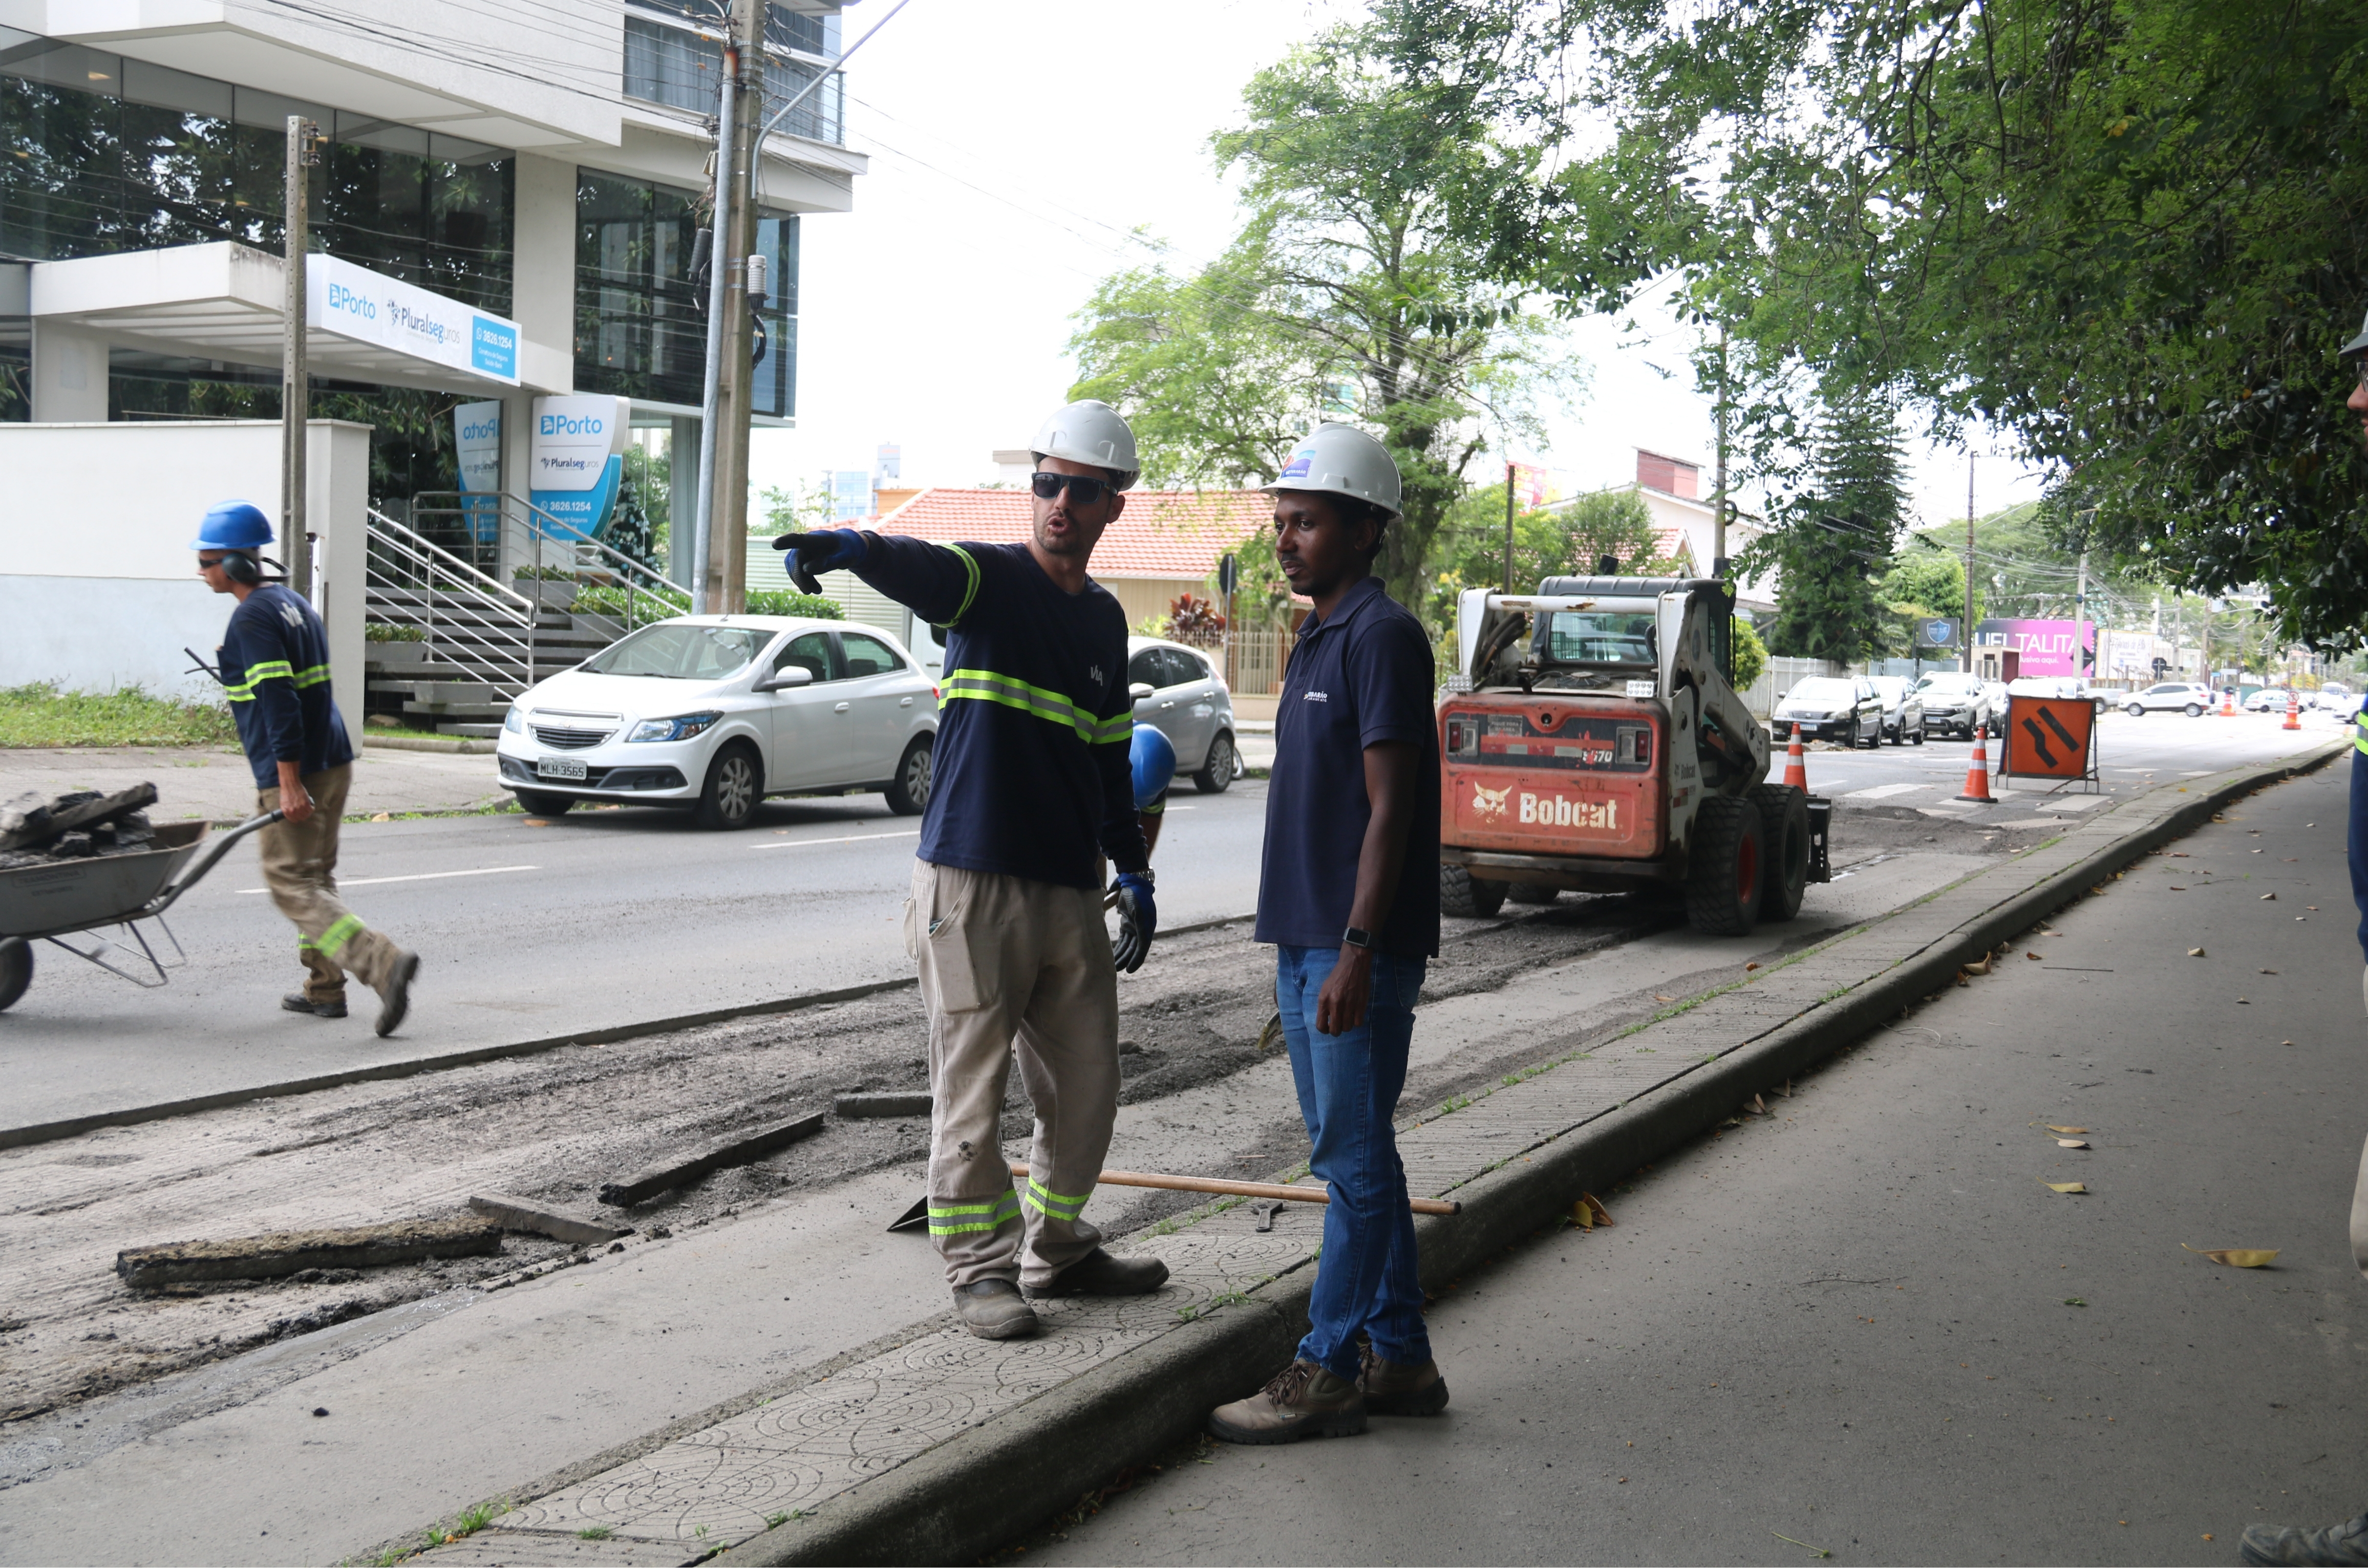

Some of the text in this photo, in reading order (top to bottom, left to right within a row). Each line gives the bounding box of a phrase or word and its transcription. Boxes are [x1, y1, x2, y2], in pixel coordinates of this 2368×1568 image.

[342, 287, 376, 319] Porto
[401, 307, 461, 344] Pluralseguros
[483, 330, 513, 350] 3626.1254
[556, 415, 603, 434] Porto
[551, 457, 599, 470] Pluralseguros
[550, 501, 591, 511] 3626.1254
[1971, 632, 2008, 647] UEL
[2041, 657, 2059, 665] aqui.
[1519, 792, 1617, 830] Bobcat
